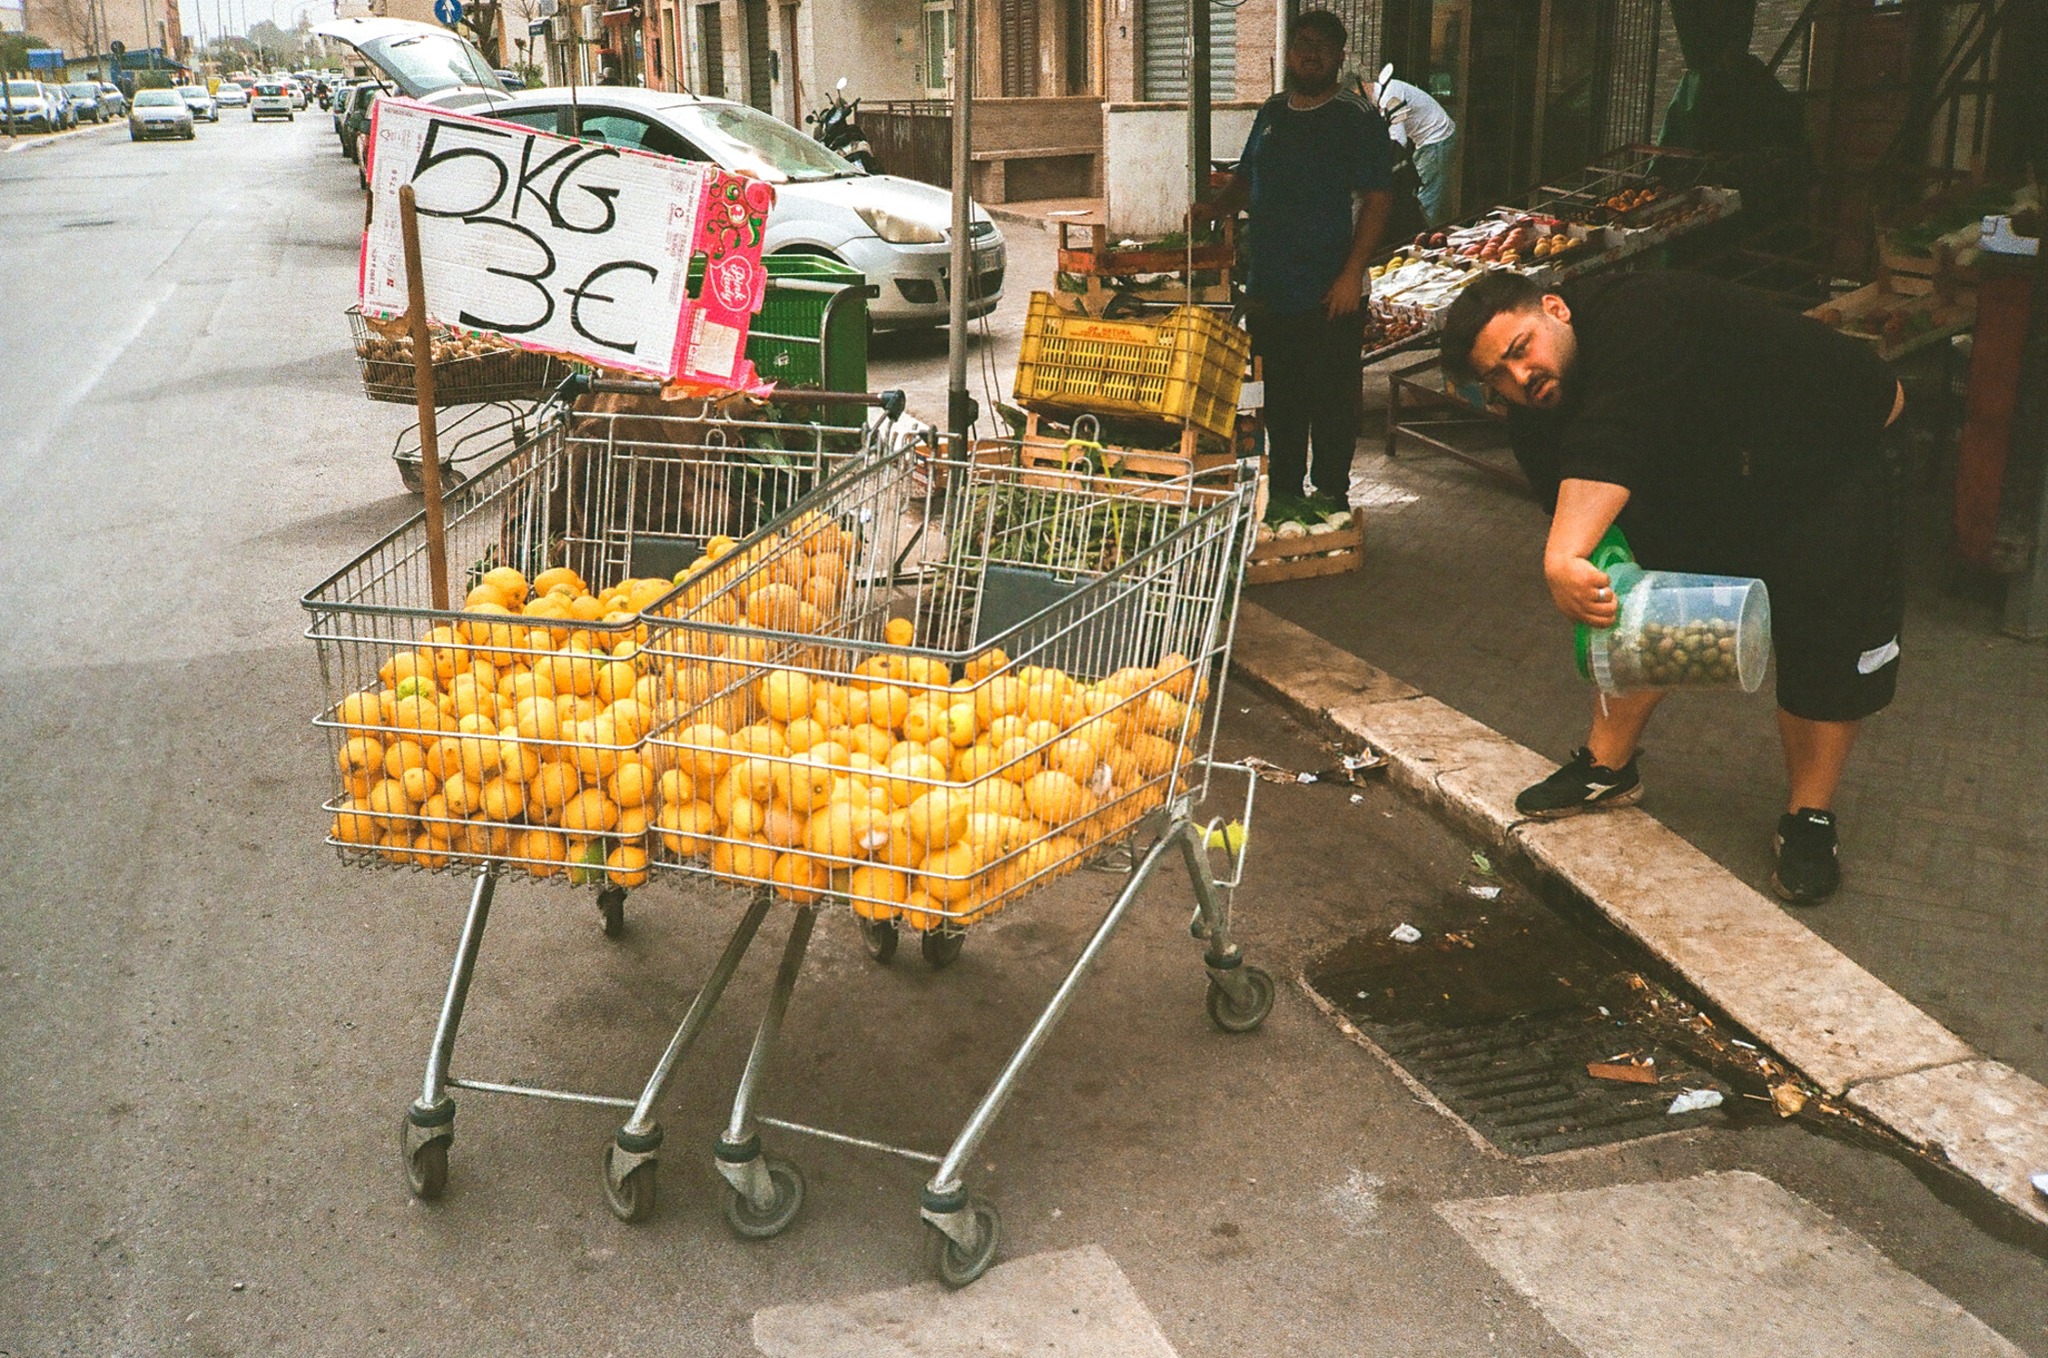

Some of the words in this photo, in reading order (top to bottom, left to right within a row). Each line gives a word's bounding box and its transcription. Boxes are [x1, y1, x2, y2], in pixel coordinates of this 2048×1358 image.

[411, 118, 620, 234] 5KG
[459, 216, 659, 354] 3€
[720, 266, 735, 302] Lady
[730, 263, 746, 301] Pink
